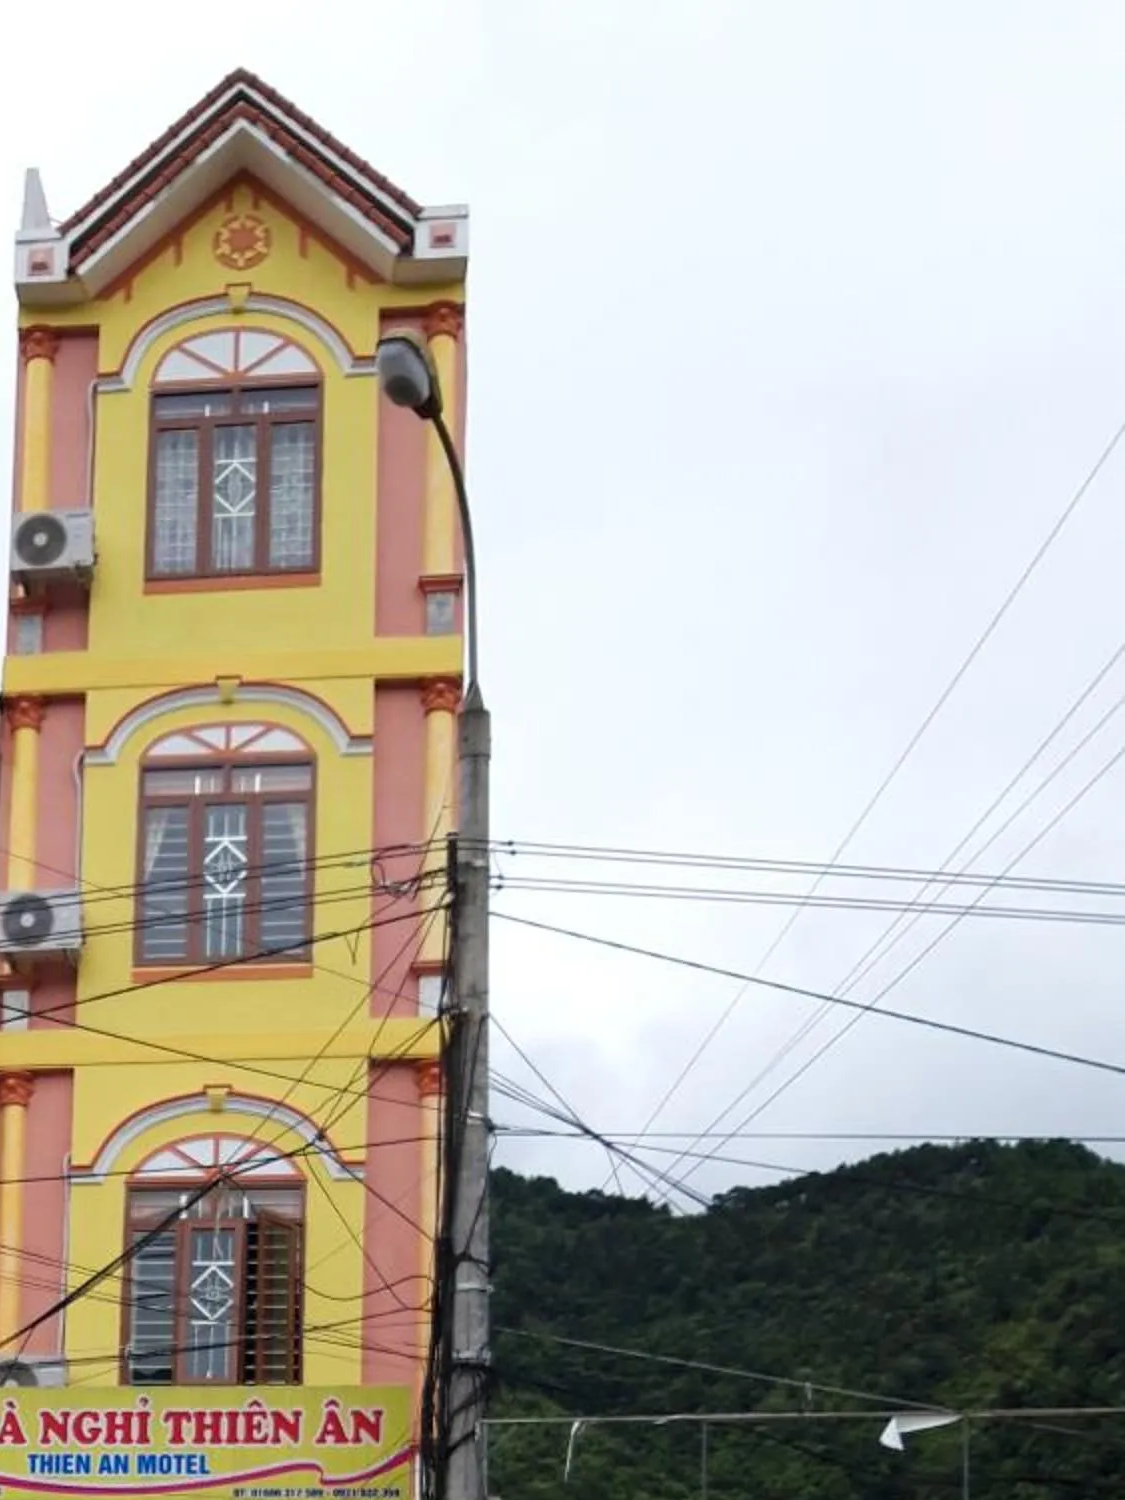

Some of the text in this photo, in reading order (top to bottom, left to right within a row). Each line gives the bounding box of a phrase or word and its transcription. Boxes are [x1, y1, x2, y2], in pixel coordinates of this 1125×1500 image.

[39, 1396, 151, 1446] NGHỈ
[162, 1399, 303, 1446] THIÊN
[315, 1398, 384, 1446] ÂN
[27, 1453, 210, 1474] THIEN AN MOTEL
